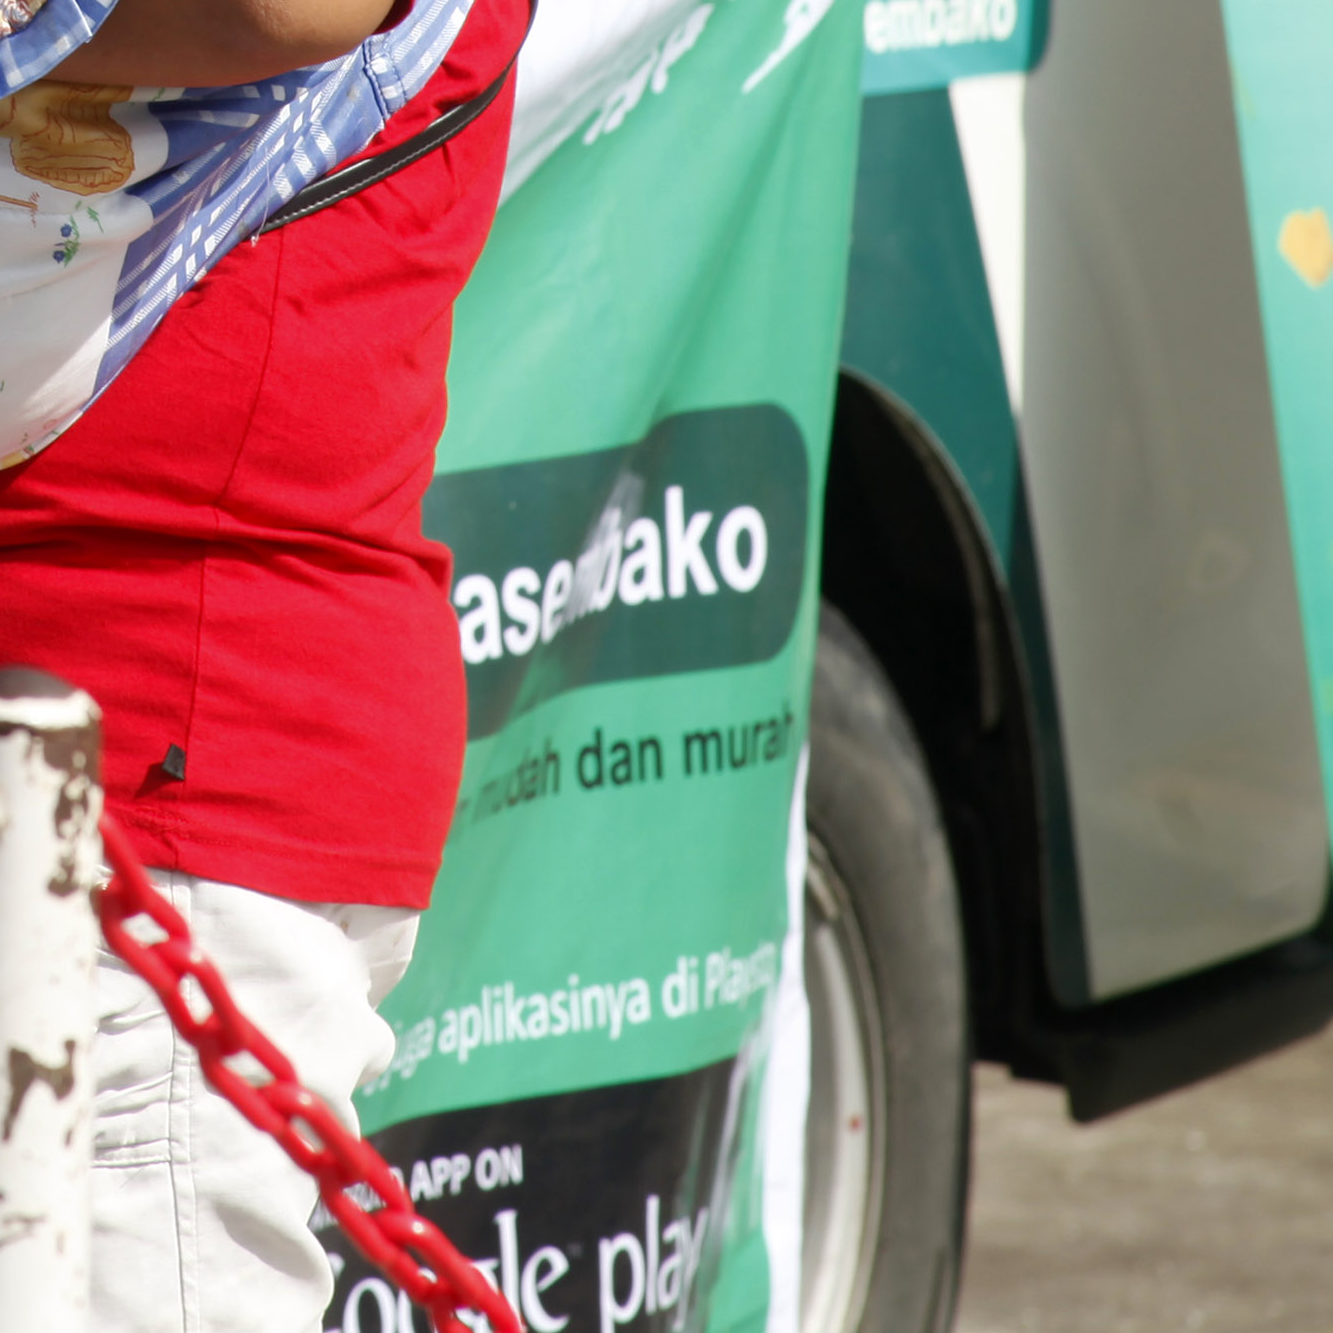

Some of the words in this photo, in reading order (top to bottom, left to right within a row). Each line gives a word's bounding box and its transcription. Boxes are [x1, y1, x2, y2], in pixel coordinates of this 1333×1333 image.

[576, 727, 664, 790] dan
[437, 974, 652, 1063] aplikasinya
[662, 956, 699, 1018] di
[410, 1153, 471, 1202] APP
[474, 1144, 523, 1191] ON
